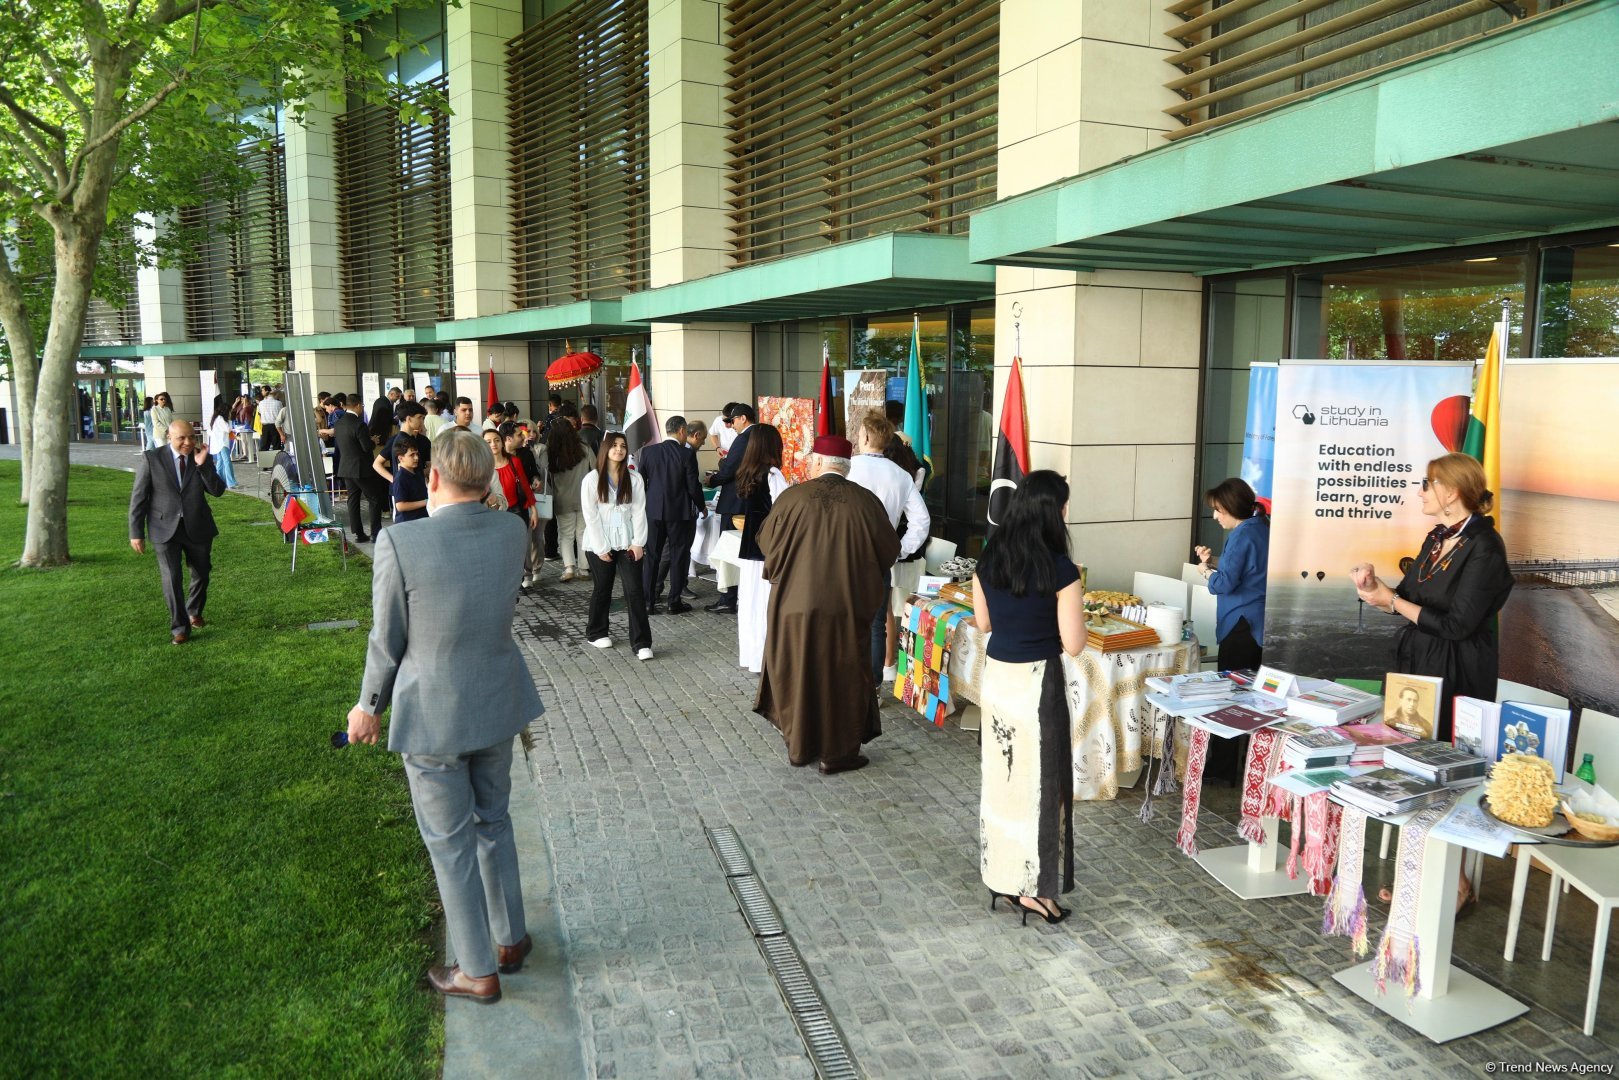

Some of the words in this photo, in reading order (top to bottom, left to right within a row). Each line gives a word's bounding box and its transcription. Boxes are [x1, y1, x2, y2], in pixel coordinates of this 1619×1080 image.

[860, 381, 875, 391] Petra
[1321, 405, 1366, 417] study
[1369, 406, 1382, 416] in
[1320, 416, 1389, 426] Lithuania
[1319, 444, 1395, 456] Education
[1318, 459, 1350, 471] with
[1354, 461, 1413, 472] endless
[1317, 475, 1407, 489] possibilities
[1316, 491, 1359, 504] learn,
[1362, 494, 1404, 506] grow,
[1315, 507, 1344, 517] and
[1348, 507, 1392, 519] thrive
